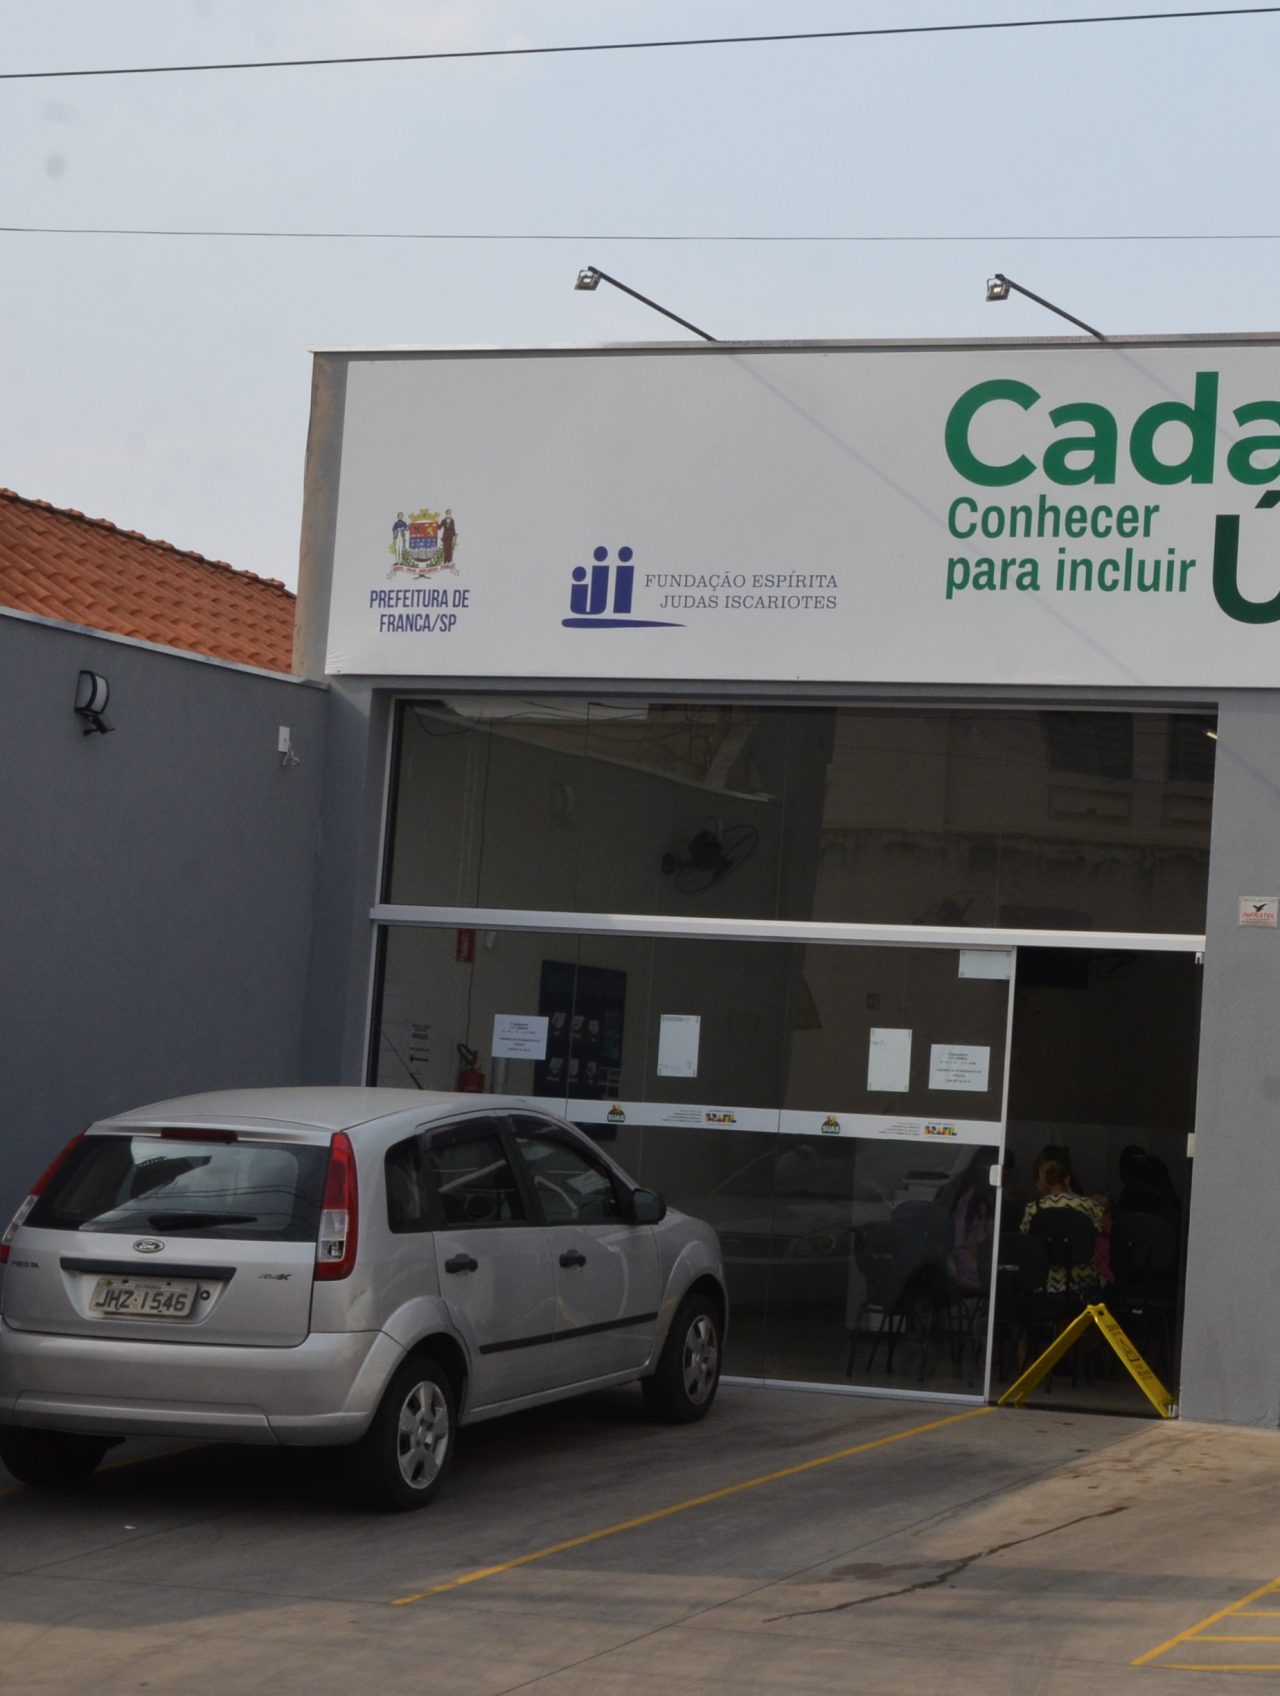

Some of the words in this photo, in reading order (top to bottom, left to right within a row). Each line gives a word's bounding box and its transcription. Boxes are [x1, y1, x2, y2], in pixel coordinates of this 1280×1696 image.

[947, 494, 1160, 539] Conhecer
[644, 571, 746, 592] FUNDAÇÃO
[751, 570, 839, 588] ESPÍRITA
[945, 556, 1041, 600] para
[1055, 547, 1197, 593] incluir
[369, 589, 449, 609] PREFEITURA
[452, 589, 471, 609] DE
[659, 594, 719, 609] JUDAS
[723, 595, 837, 610] ISCARIOTES
[379, 613, 457, 633] FRANCA/SP
